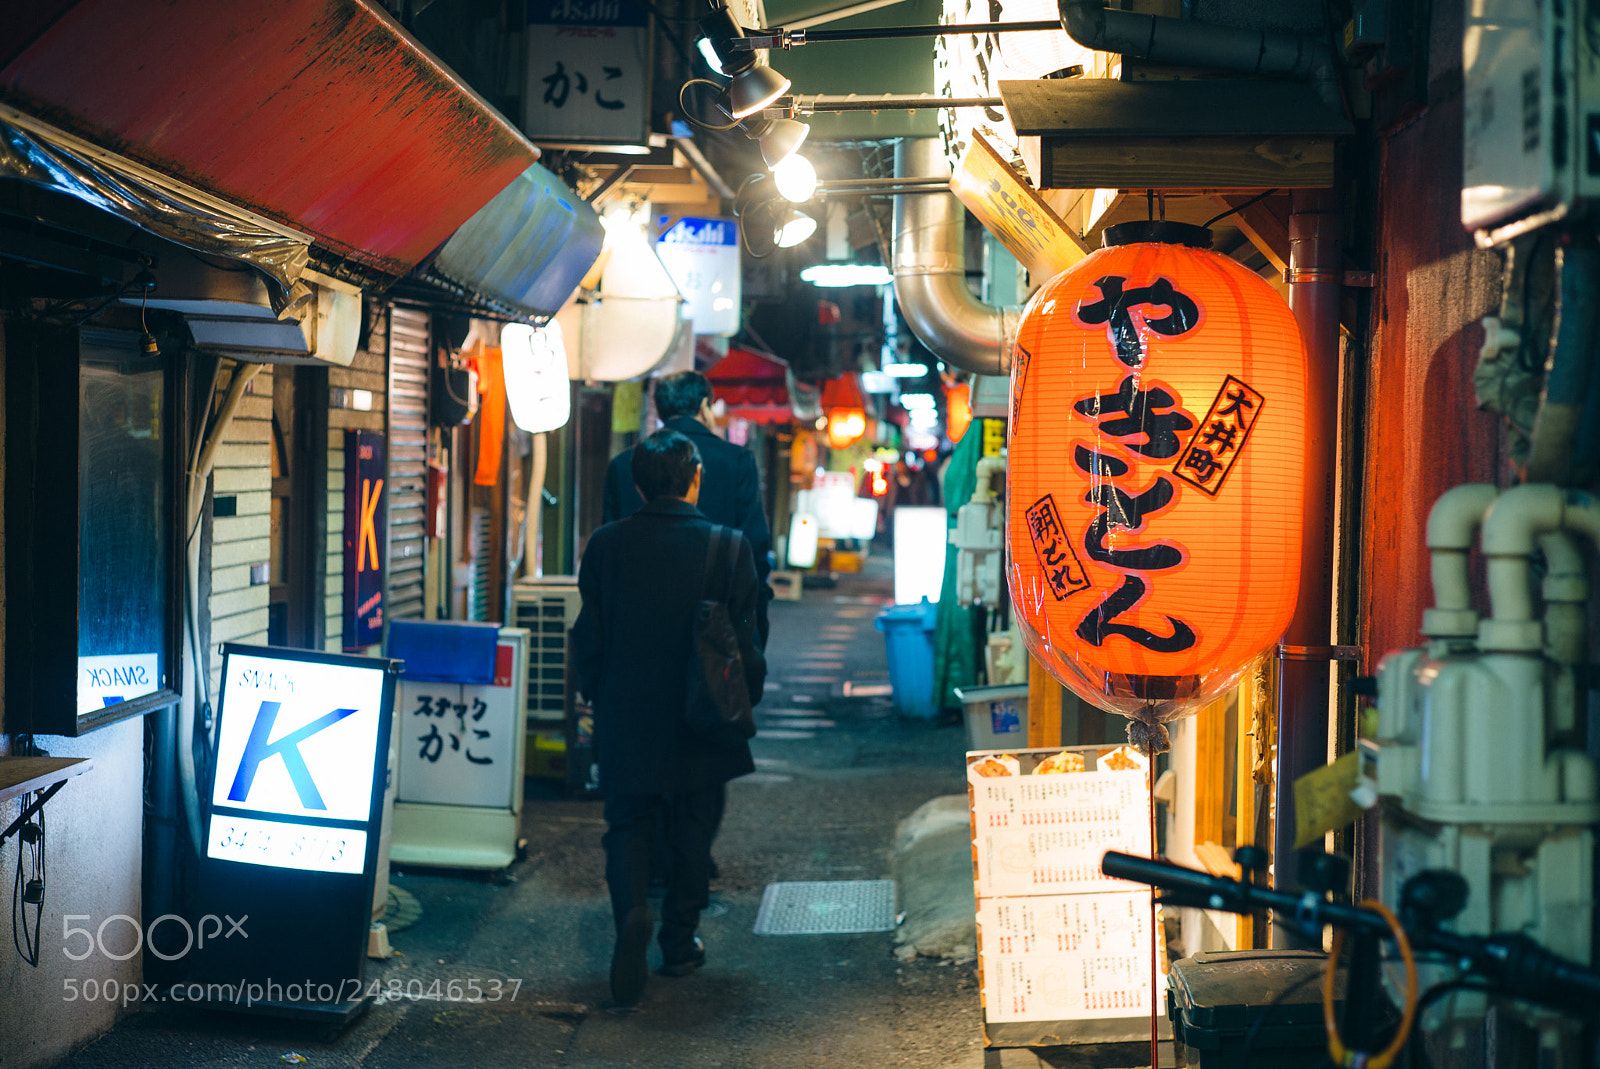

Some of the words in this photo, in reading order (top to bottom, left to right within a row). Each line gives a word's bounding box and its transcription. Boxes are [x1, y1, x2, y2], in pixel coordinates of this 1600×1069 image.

[542, 61, 625, 110] かこ
[1076, 276, 1199, 652] やきとん
[1185, 389, 1253, 483] 大井町
[357, 478, 383, 572] K
[1031, 504, 1083, 591] 朝どれ
[413, 696, 488, 721] スナック
[418, 724, 494, 765] かこ
[227, 701, 360, 811] K
